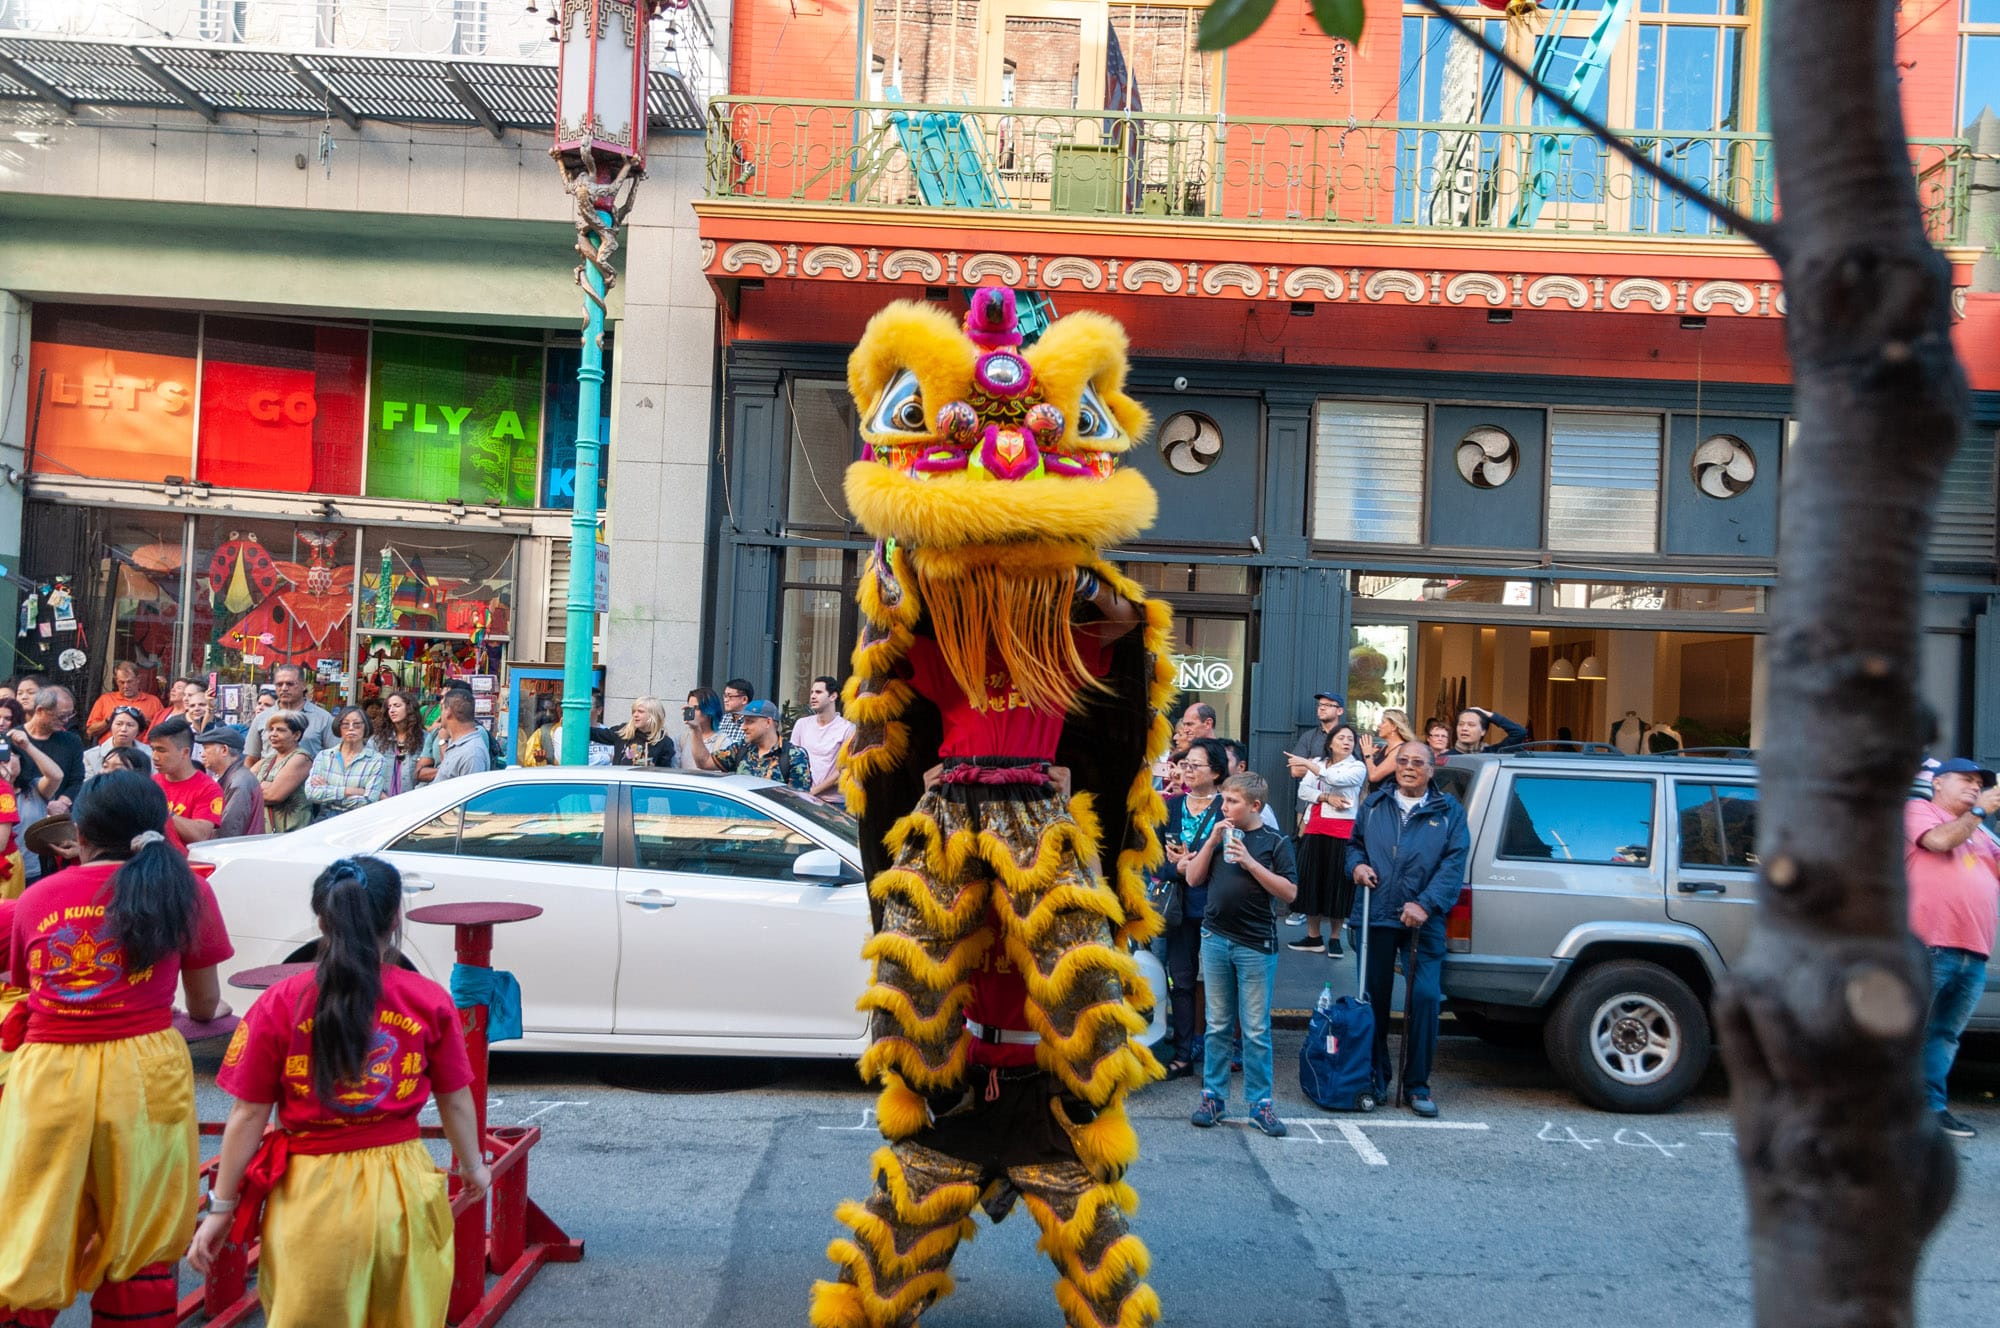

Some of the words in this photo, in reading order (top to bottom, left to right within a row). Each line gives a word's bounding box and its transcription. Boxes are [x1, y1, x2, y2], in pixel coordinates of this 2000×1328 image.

[52, 372, 190, 413] LET'S
[250, 391, 317, 424] GO
[382, 401, 473, 435] FLY
[492, 410, 526, 440] A
[1635, 598, 1662, 609] 729
[1172, 662, 1233, 690] NO
[37, 911, 59, 934] YAU
[64, 905, 105, 920] KUNG
[379, 1009, 423, 1036] MOON
